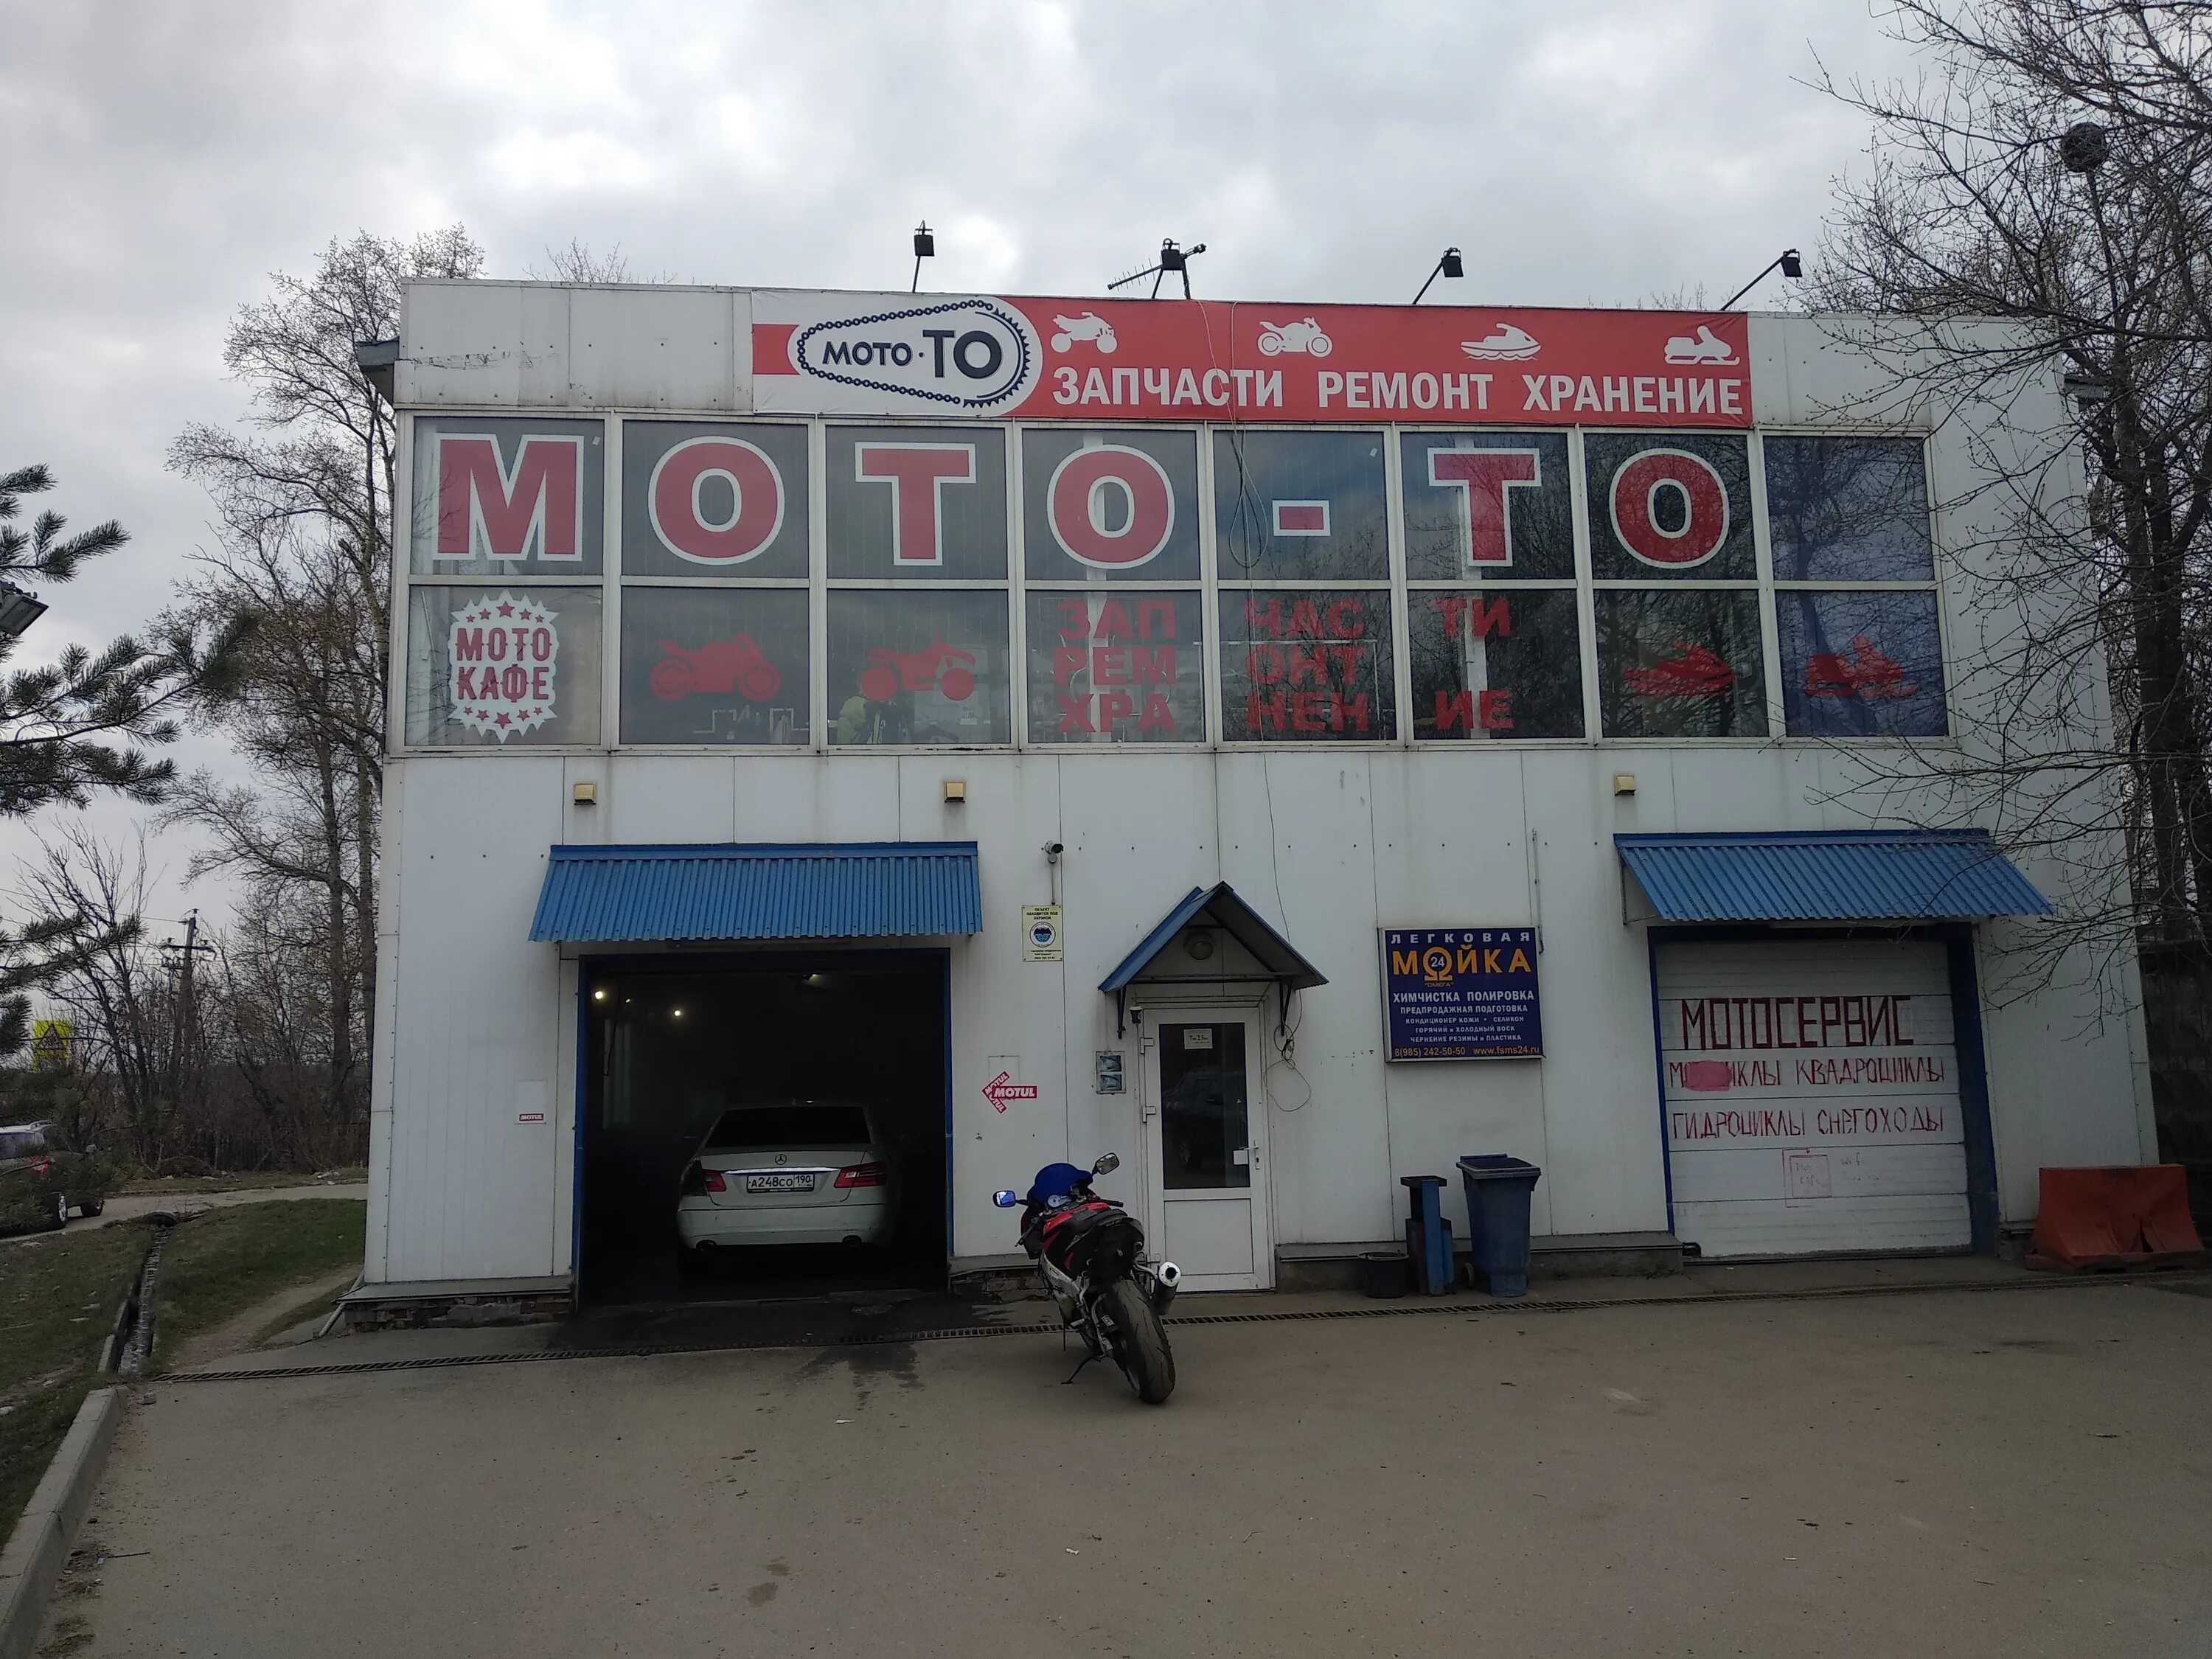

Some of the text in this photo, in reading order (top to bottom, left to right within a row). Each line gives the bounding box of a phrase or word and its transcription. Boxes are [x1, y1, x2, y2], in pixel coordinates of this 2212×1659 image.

[1052, 366, 1742, 415] ЗАПЧАСТИ РЕМОНТ ХРАНЕНИЕ
[456, 627, 552, 661] МОТО
[456, 664, 549, 703] КАФЕ
[1391, 931, 1530, 945] ЛЕГКОВАЯ
[1430, 956, 1446, 967] 24
[1393, 990, 1535, 1003] ХИМЧИСТКА ПОЛИРОВКА
[1400, 1004, 1528, 1015] ПРЕДПРОДАЖНАЯ ПОДГОТОВКА
[1405, 1017, 1457, 1025] КОНДИЦИОНЕР
[1682, 996, 1913, 1049] МОТОСЕРВИС
[1416, 1025, 1447, 1034] ГОРЯЧИЙ
[1455, 1025, 1494, 1033] ХОЛОДНЫЙ
[1410, 1035, 1447, 1043] ЧЕРНЕНИЕ
[1394, 1045, 1540, 1057] 8(985) 242-50-50 www.fsms24.ru
[1795, 1057, 1944, 1085] КВАДРОЦИКЛЫ
[993, 1088, 1035, 1097] MOTUL
[1672, 1107, 1943, 1138] ГИДРОЦИКЛЫ СНЕГОХОДЫ
[796, 1175, 810, 1183] 190
